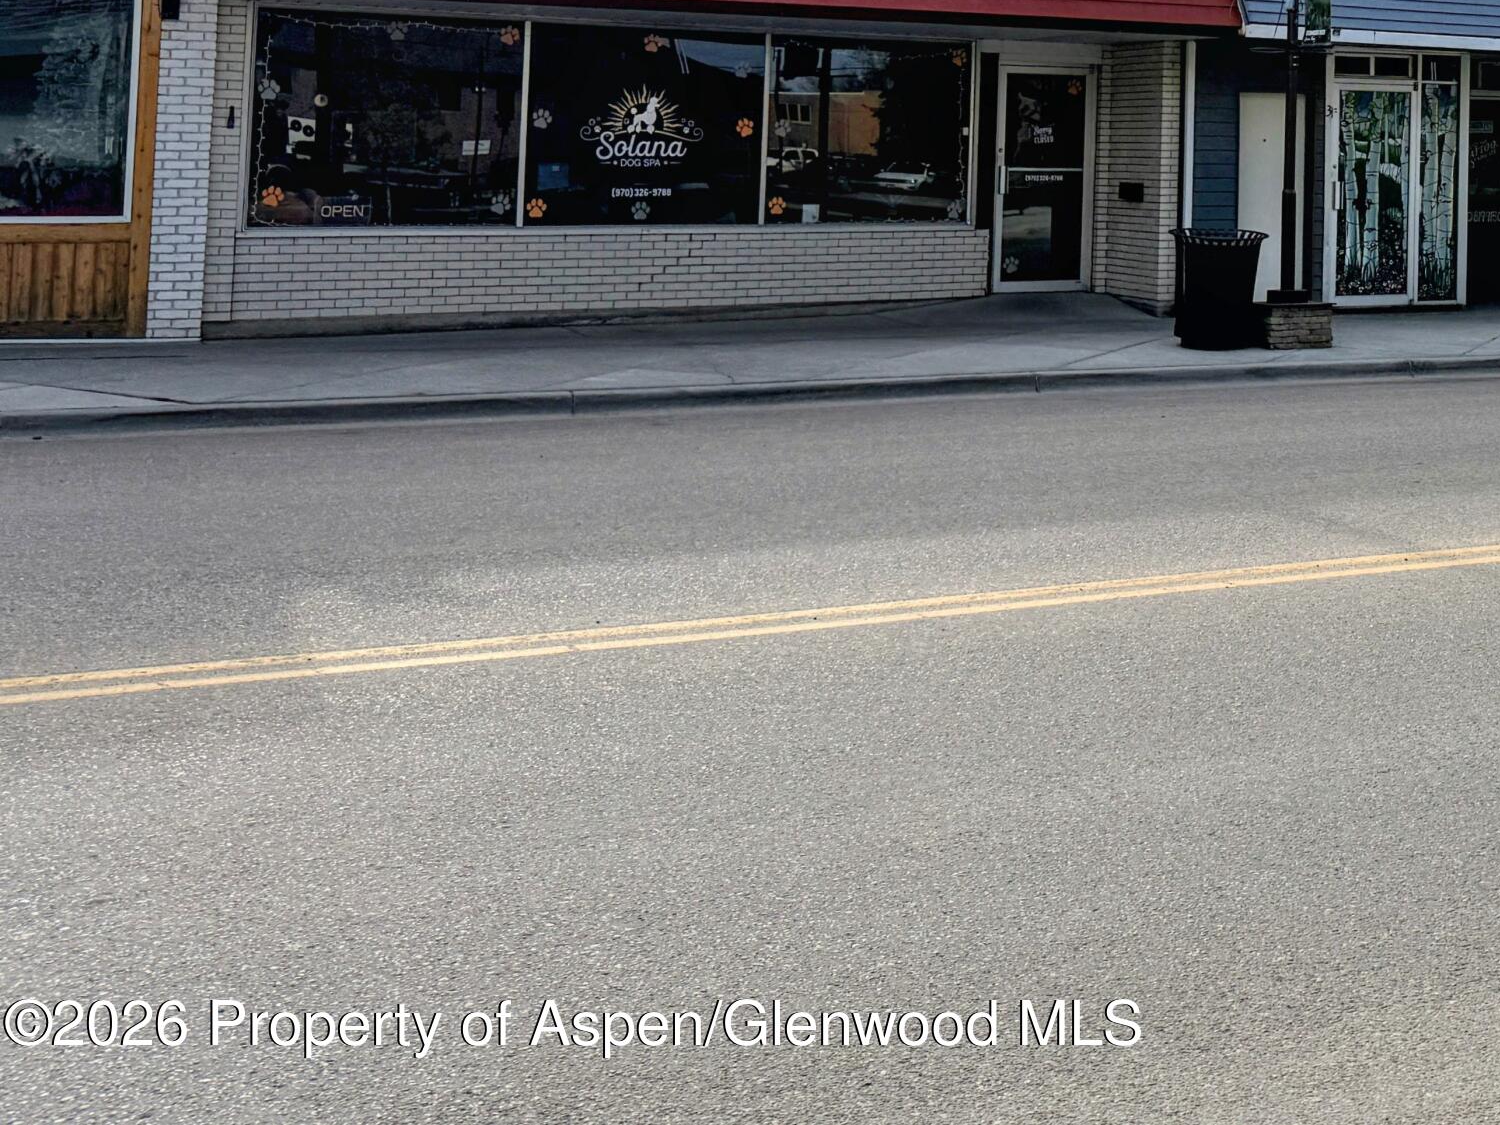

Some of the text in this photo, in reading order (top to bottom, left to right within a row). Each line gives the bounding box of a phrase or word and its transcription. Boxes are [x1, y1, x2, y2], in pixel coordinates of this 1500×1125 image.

[595, 131, 688, 160] Solana
[620, 158, 661, 168] DOG SPA
[320, 204, 364, 218] OPEN
